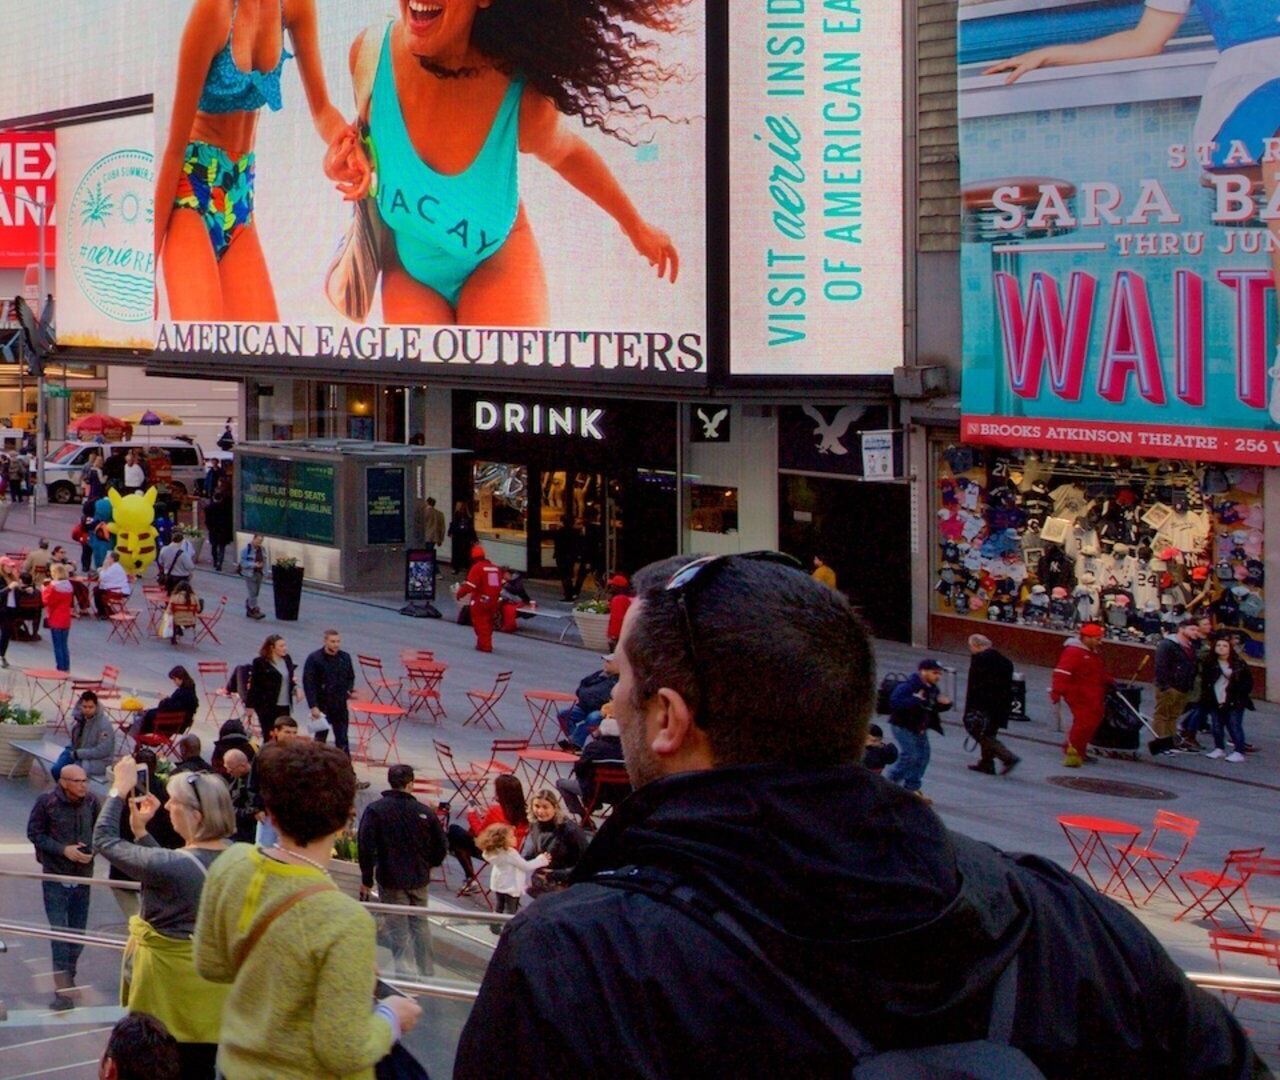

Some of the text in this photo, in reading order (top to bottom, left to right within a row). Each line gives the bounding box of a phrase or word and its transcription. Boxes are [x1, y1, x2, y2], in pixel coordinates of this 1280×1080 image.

[756, 113, 806, 241] aerie
[823, 69, 862, 245] AMERICAN
[992, 177, 1181, 230] SARA
[1115, 231, 1205, 256] THRU
[768, 249, 806, 347] VISIT
[823, 259, 862, 303] OF
[156, 323, 704, 371] AMERICAN EAGLE OUTFITTERS
[994, 269, 1278, 409] WAIT
[475, 400, 605, 440] DRINK
[980, 423, 1267, 453] BROOKS ATKINSON THEATRE 256
[1138, 574, 1158, 587] 24
[1011, 701, 1022, 713] 2
